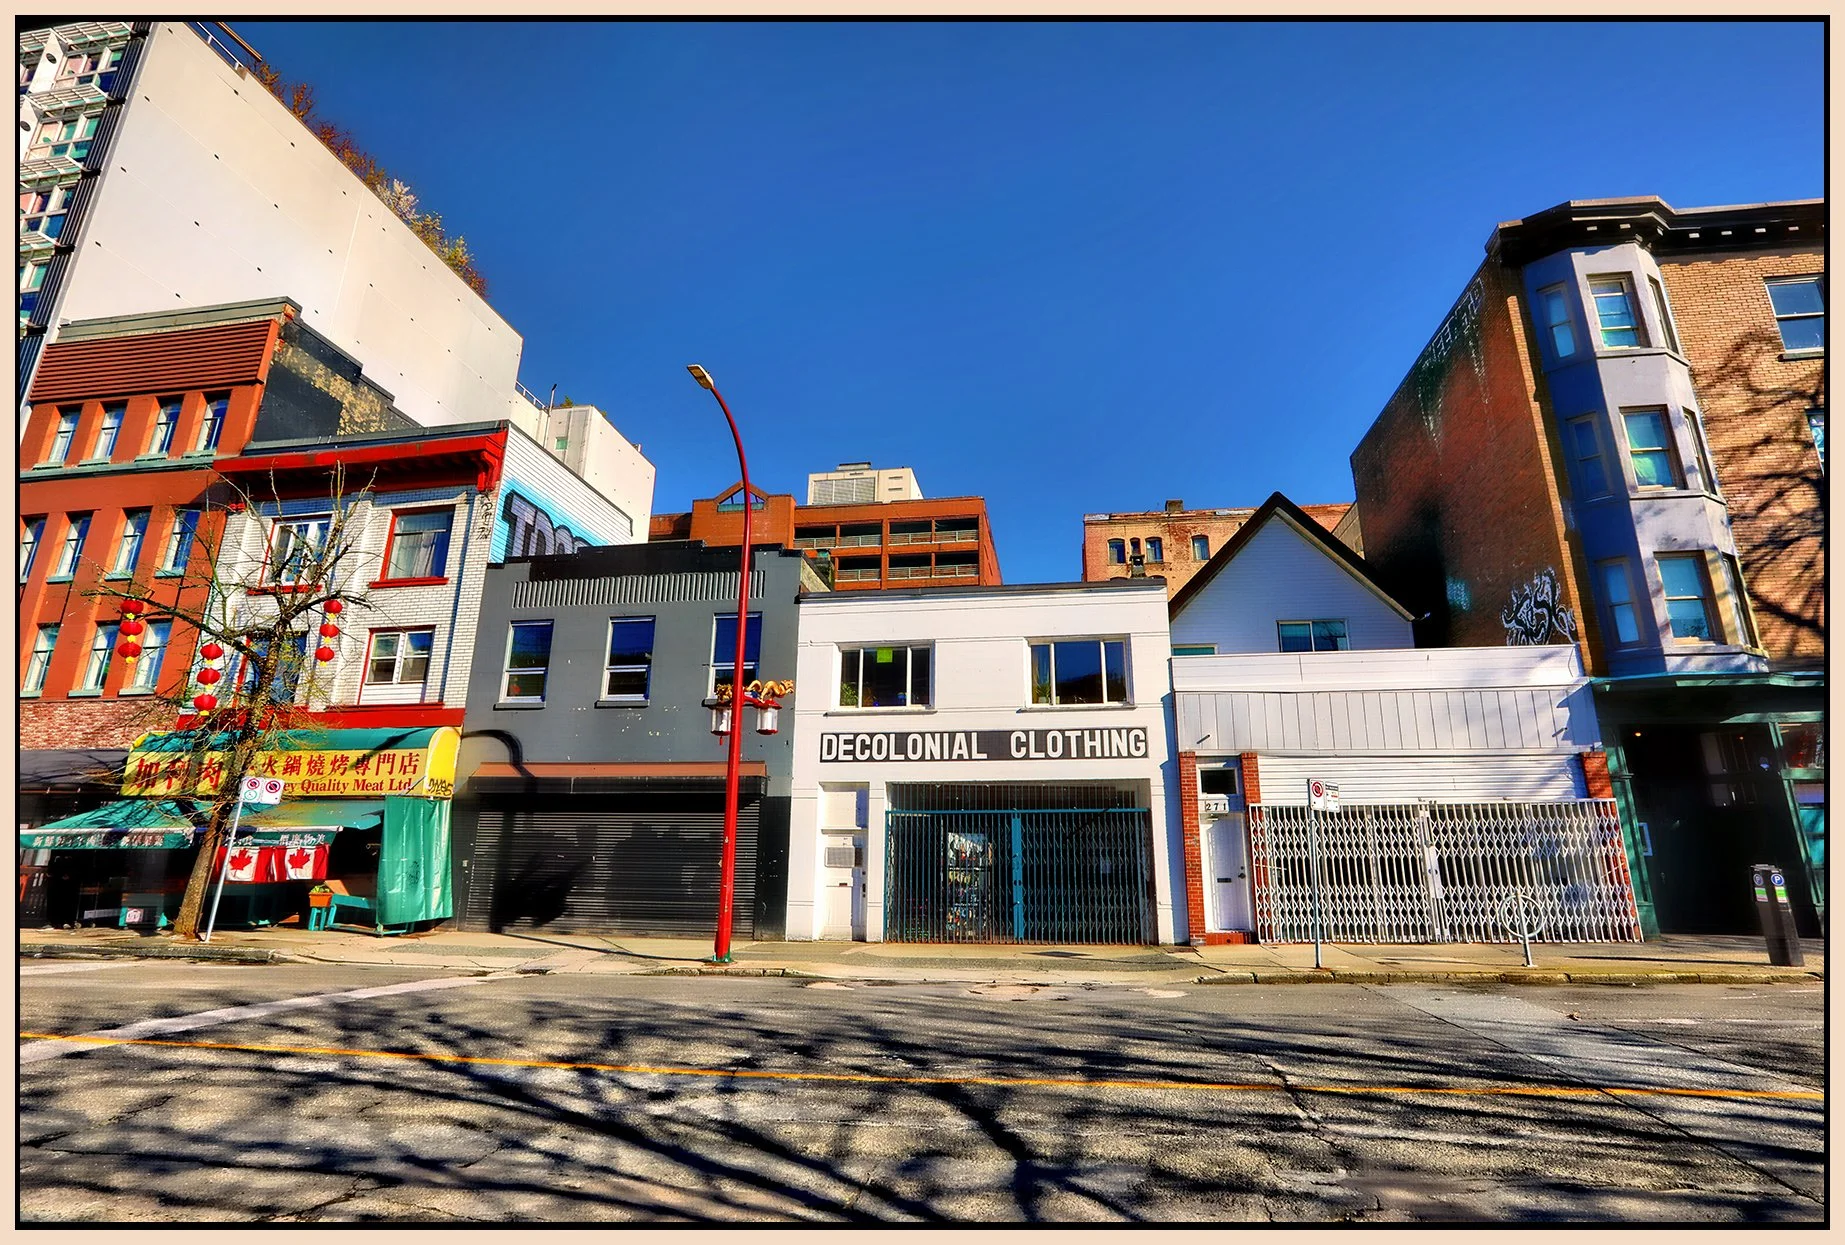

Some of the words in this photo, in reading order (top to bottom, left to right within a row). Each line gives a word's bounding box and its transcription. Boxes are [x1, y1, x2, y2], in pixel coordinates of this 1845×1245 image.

[821, 731, 988, 761] DECOLONIAL
[1011, 729, 1147, 759] CLOTHING
[301, 778, 350, 794] Quality
[353, 778, 384, 791] Meat
[1205, 803, 1227, 811] 271
